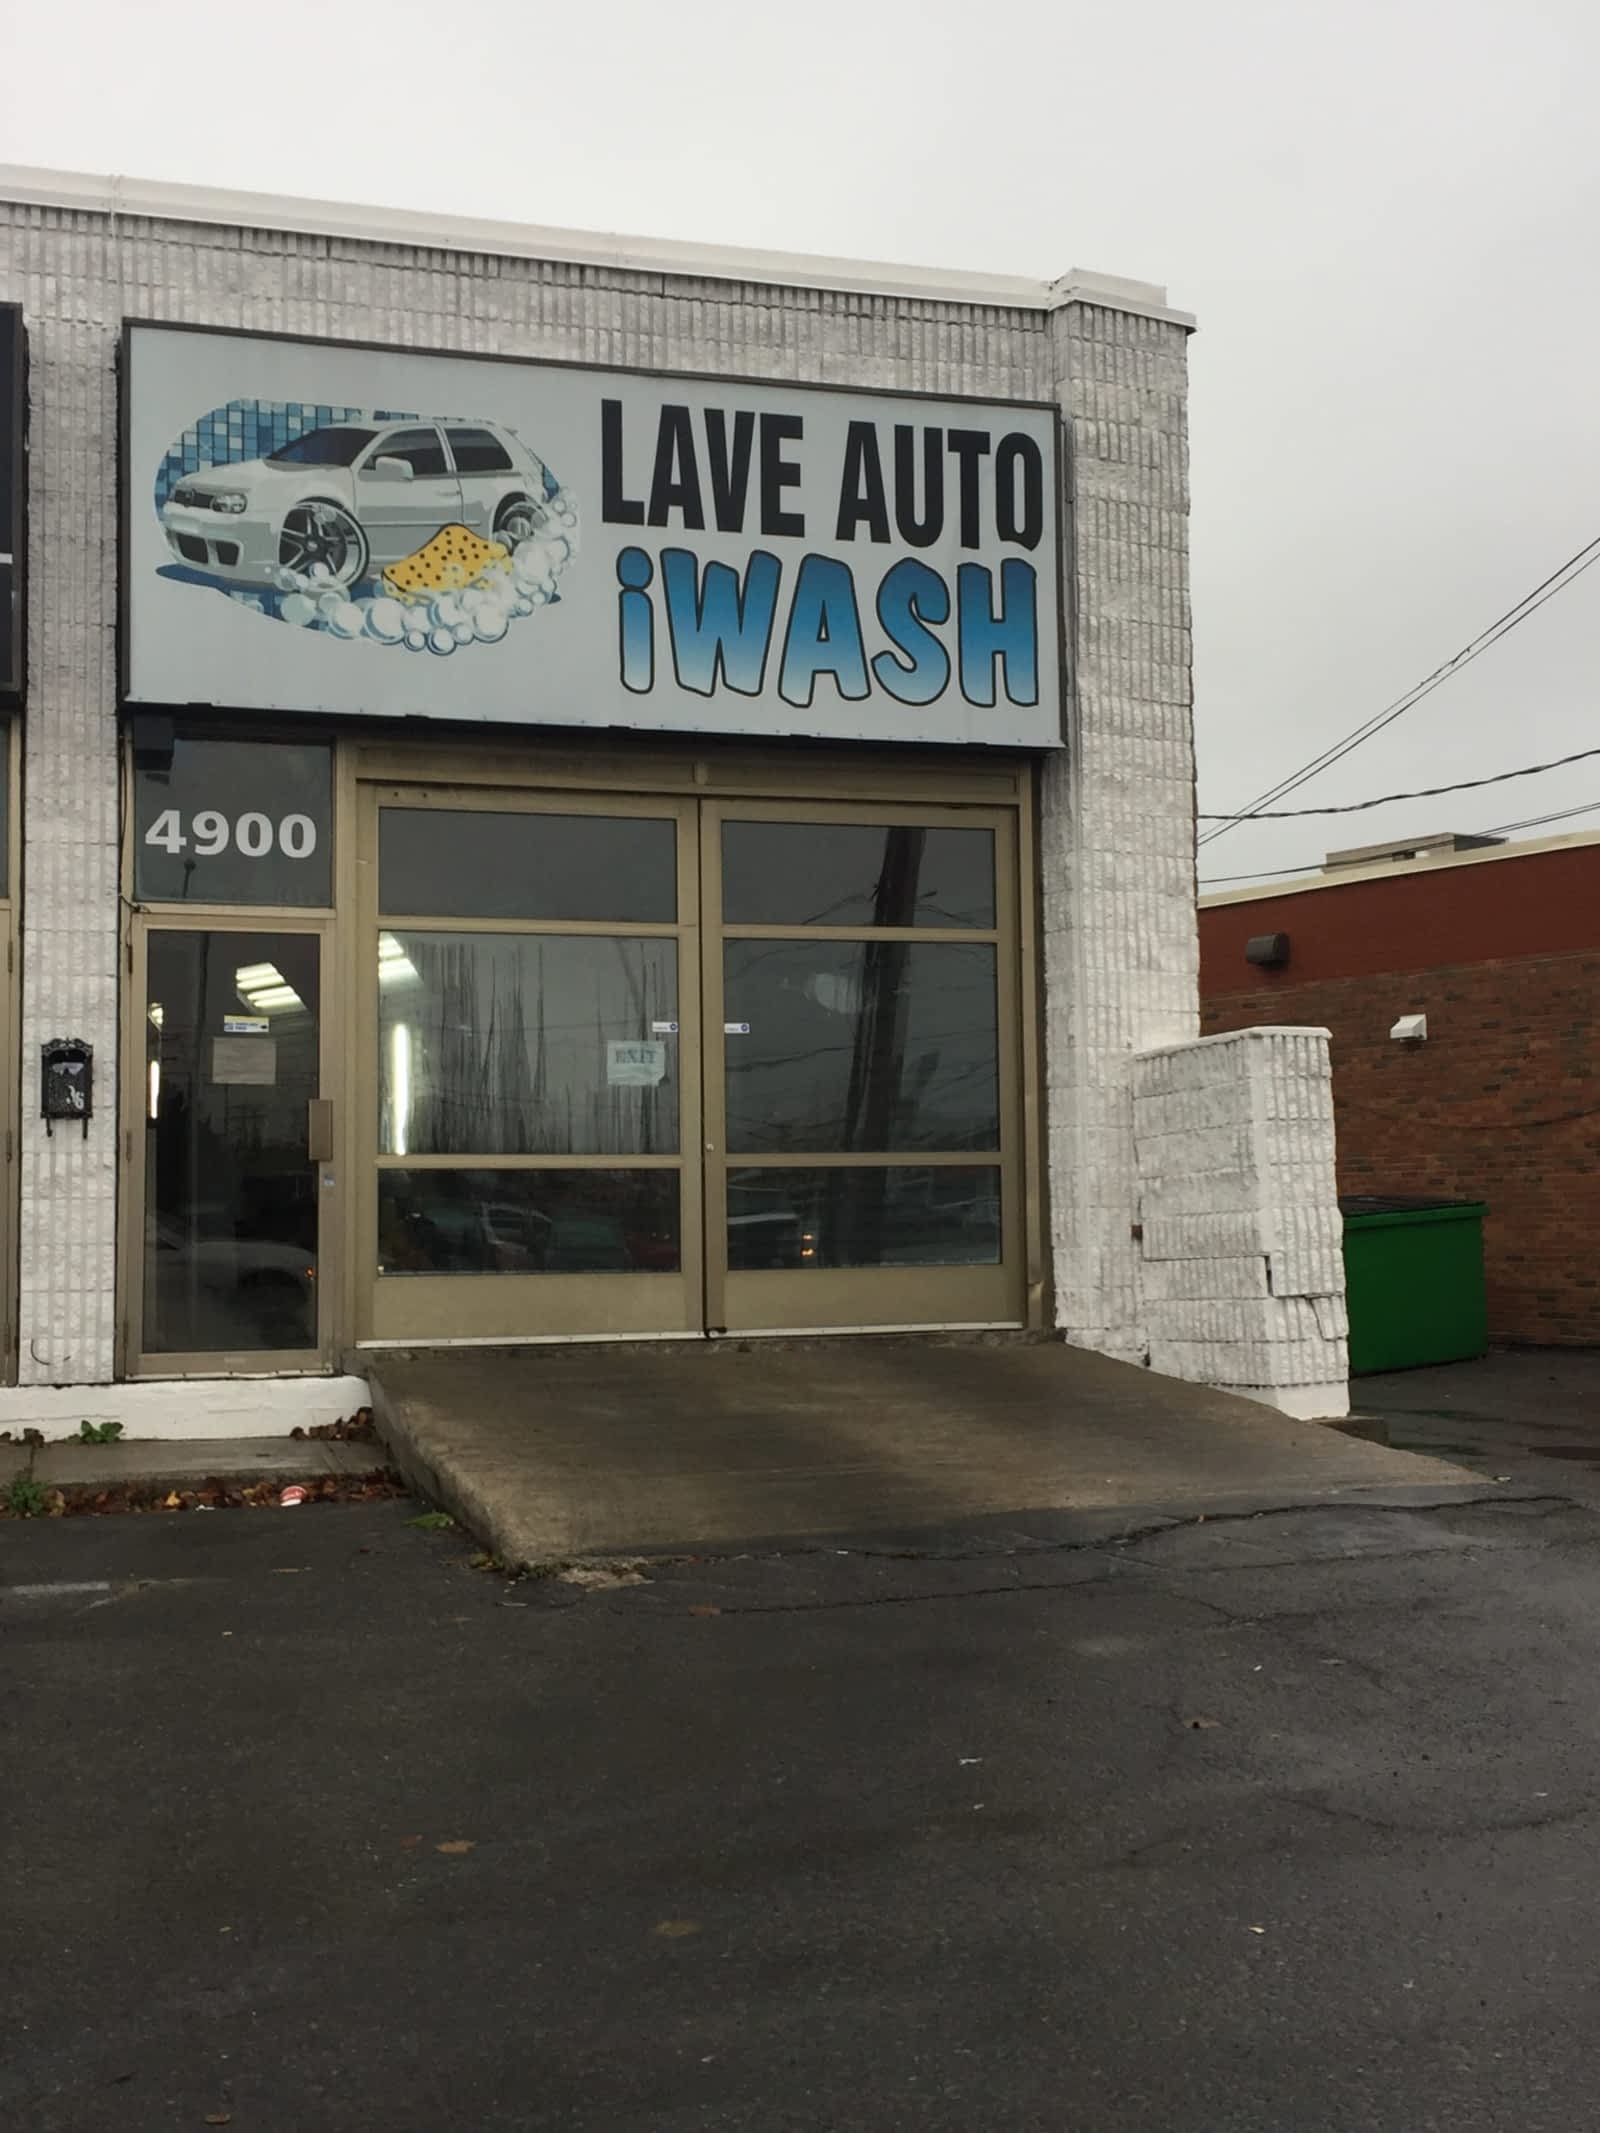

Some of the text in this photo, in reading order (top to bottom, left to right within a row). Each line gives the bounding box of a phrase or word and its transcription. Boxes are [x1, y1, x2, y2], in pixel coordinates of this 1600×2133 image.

[601, 398, 1043, 552] LAVE AUTO
[616, 545, 1039, 709] iWASH
[145, 809, 316, 859] 4900
[615, 1049, 657, 1065] EXIT
